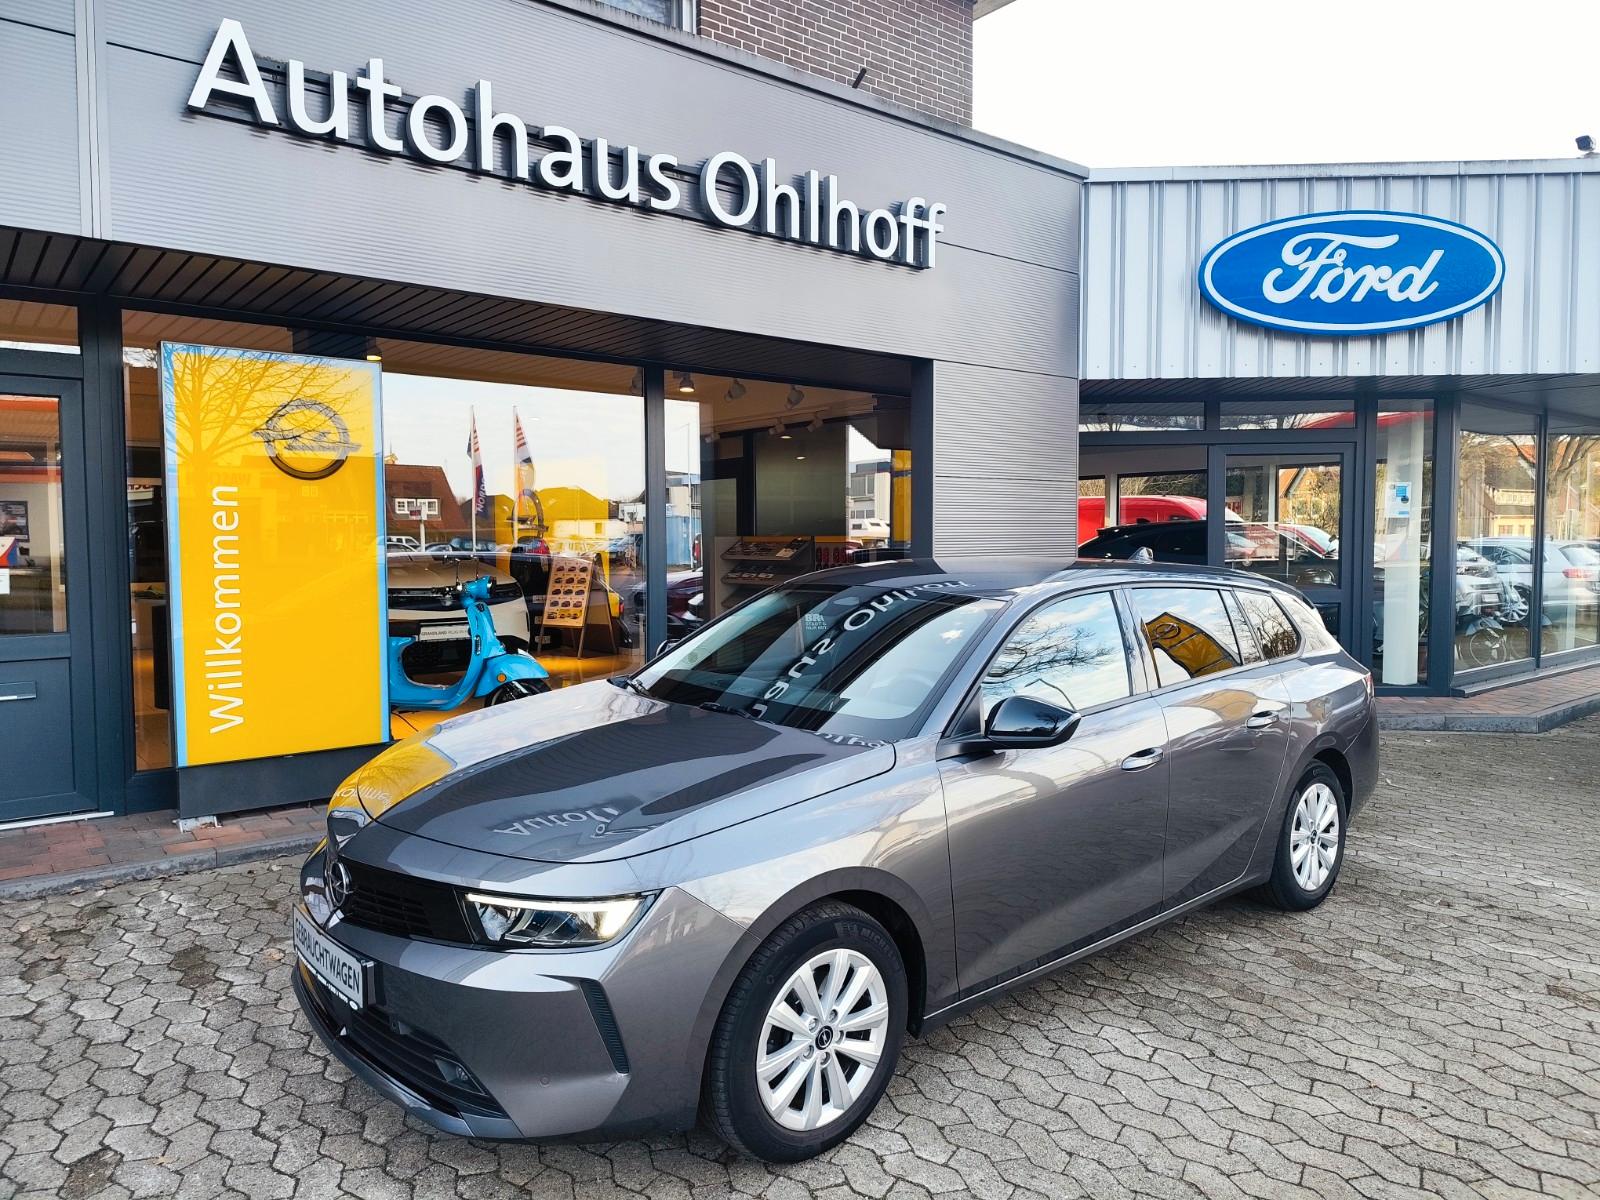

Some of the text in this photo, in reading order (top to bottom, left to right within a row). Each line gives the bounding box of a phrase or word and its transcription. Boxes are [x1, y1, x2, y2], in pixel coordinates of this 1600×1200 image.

[187, 18, 947, 270] Autohaus Ohlhoff
[1262, 231, 1445, 304] Ford
[204, 485, 244, 734] Willkommen
[296, 918, 360, 994] GEBRAUCHTWAGEN
